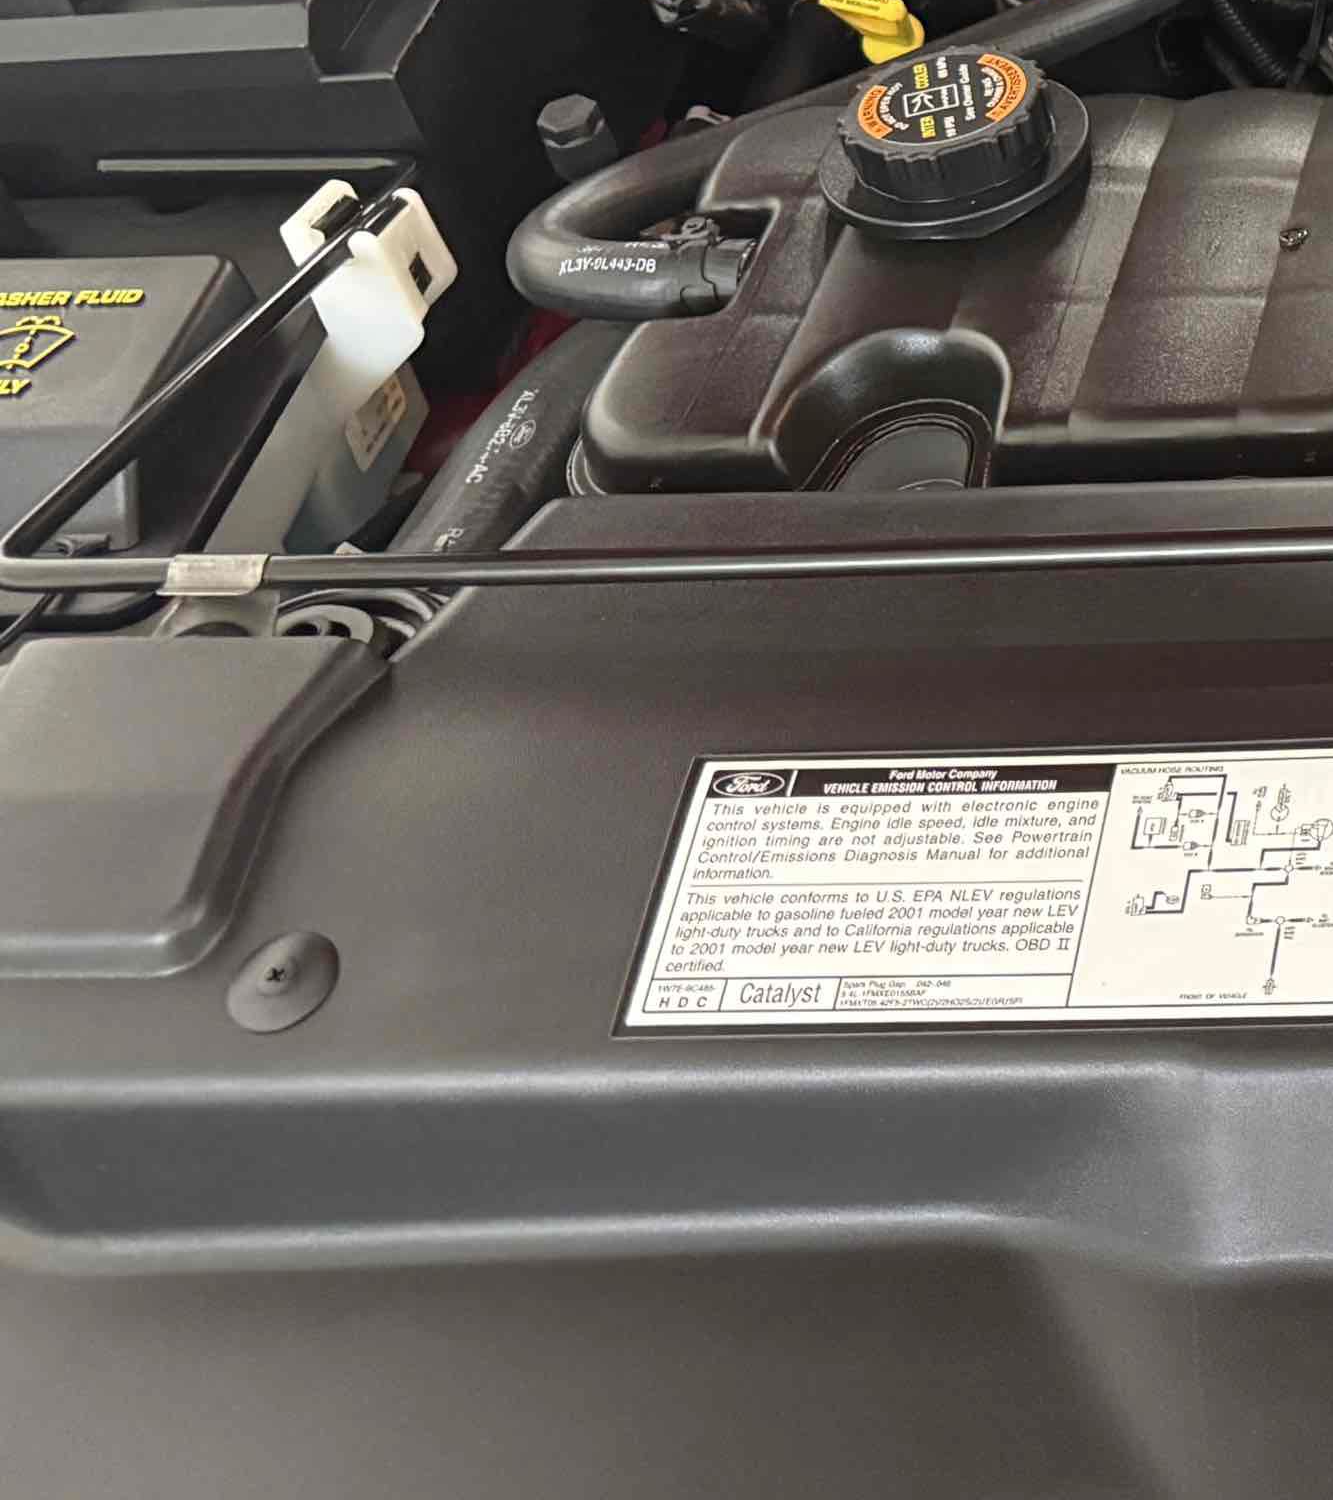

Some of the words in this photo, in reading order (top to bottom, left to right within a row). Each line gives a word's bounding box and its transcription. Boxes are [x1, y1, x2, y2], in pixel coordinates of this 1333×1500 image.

[74, 289, 145, 306] FLUID
[888, 770, 915, 780] Ford
[915, 769, 947, 779] Motor
[948, 769, 997, 780] Company
[823, 782, 870, 794] VEHICLE
[870, 782, 925, 793] EMISSION
[927, 781, 977, 793] CONTROL
[980, 779, 1057, 791] INFORMATION
[714, 803, 744, 815] This
[754, 803, 807, 815] vehicle
[817, 803, 830, 814] is
[840, 801, 912, 816] equipped
[921, 801, 951, 812] with
[961, 800, 1037, 812] electronic
[1047, 799, 1099, 813] engine
[706, 819, 757, 831] control
[761, 819, 823, 830] systems.
[831, 817, 880, 832] Engine
[886, 817, 912, 829] idle
[918, 817, 965, 830] speed,
[972, 815, 998, 827] idle
[1004, 815, 1061, 827] mixture,
[1068, 814, 1096, 826] and
[702, 835, 757, 850] ignition
[765, 836, 810, 849] timing
[818, 835, 843, 846] are
[851, 834, 876, 845] not
[883, 832, 963, 847] adjustable.
[973, 831, 1003, 844] See
[1011, 830, 1092, 843] Powertrain
[698, 850, 836, 863] Control/Emissions
[844, 849, 917, 864] Diagnosis
[926, 847, 980, 860] Manual
[988, 847, 1008, 859] for
[1015, 846, 1090, 859] additional
[692, 867, 773, 879] information.
[739, 982, 821, 1003] Catalyst
[659, 997, 670, 1007] H
[677, 996, 688, 1008] D
[696, 996, 707, 1008] C
